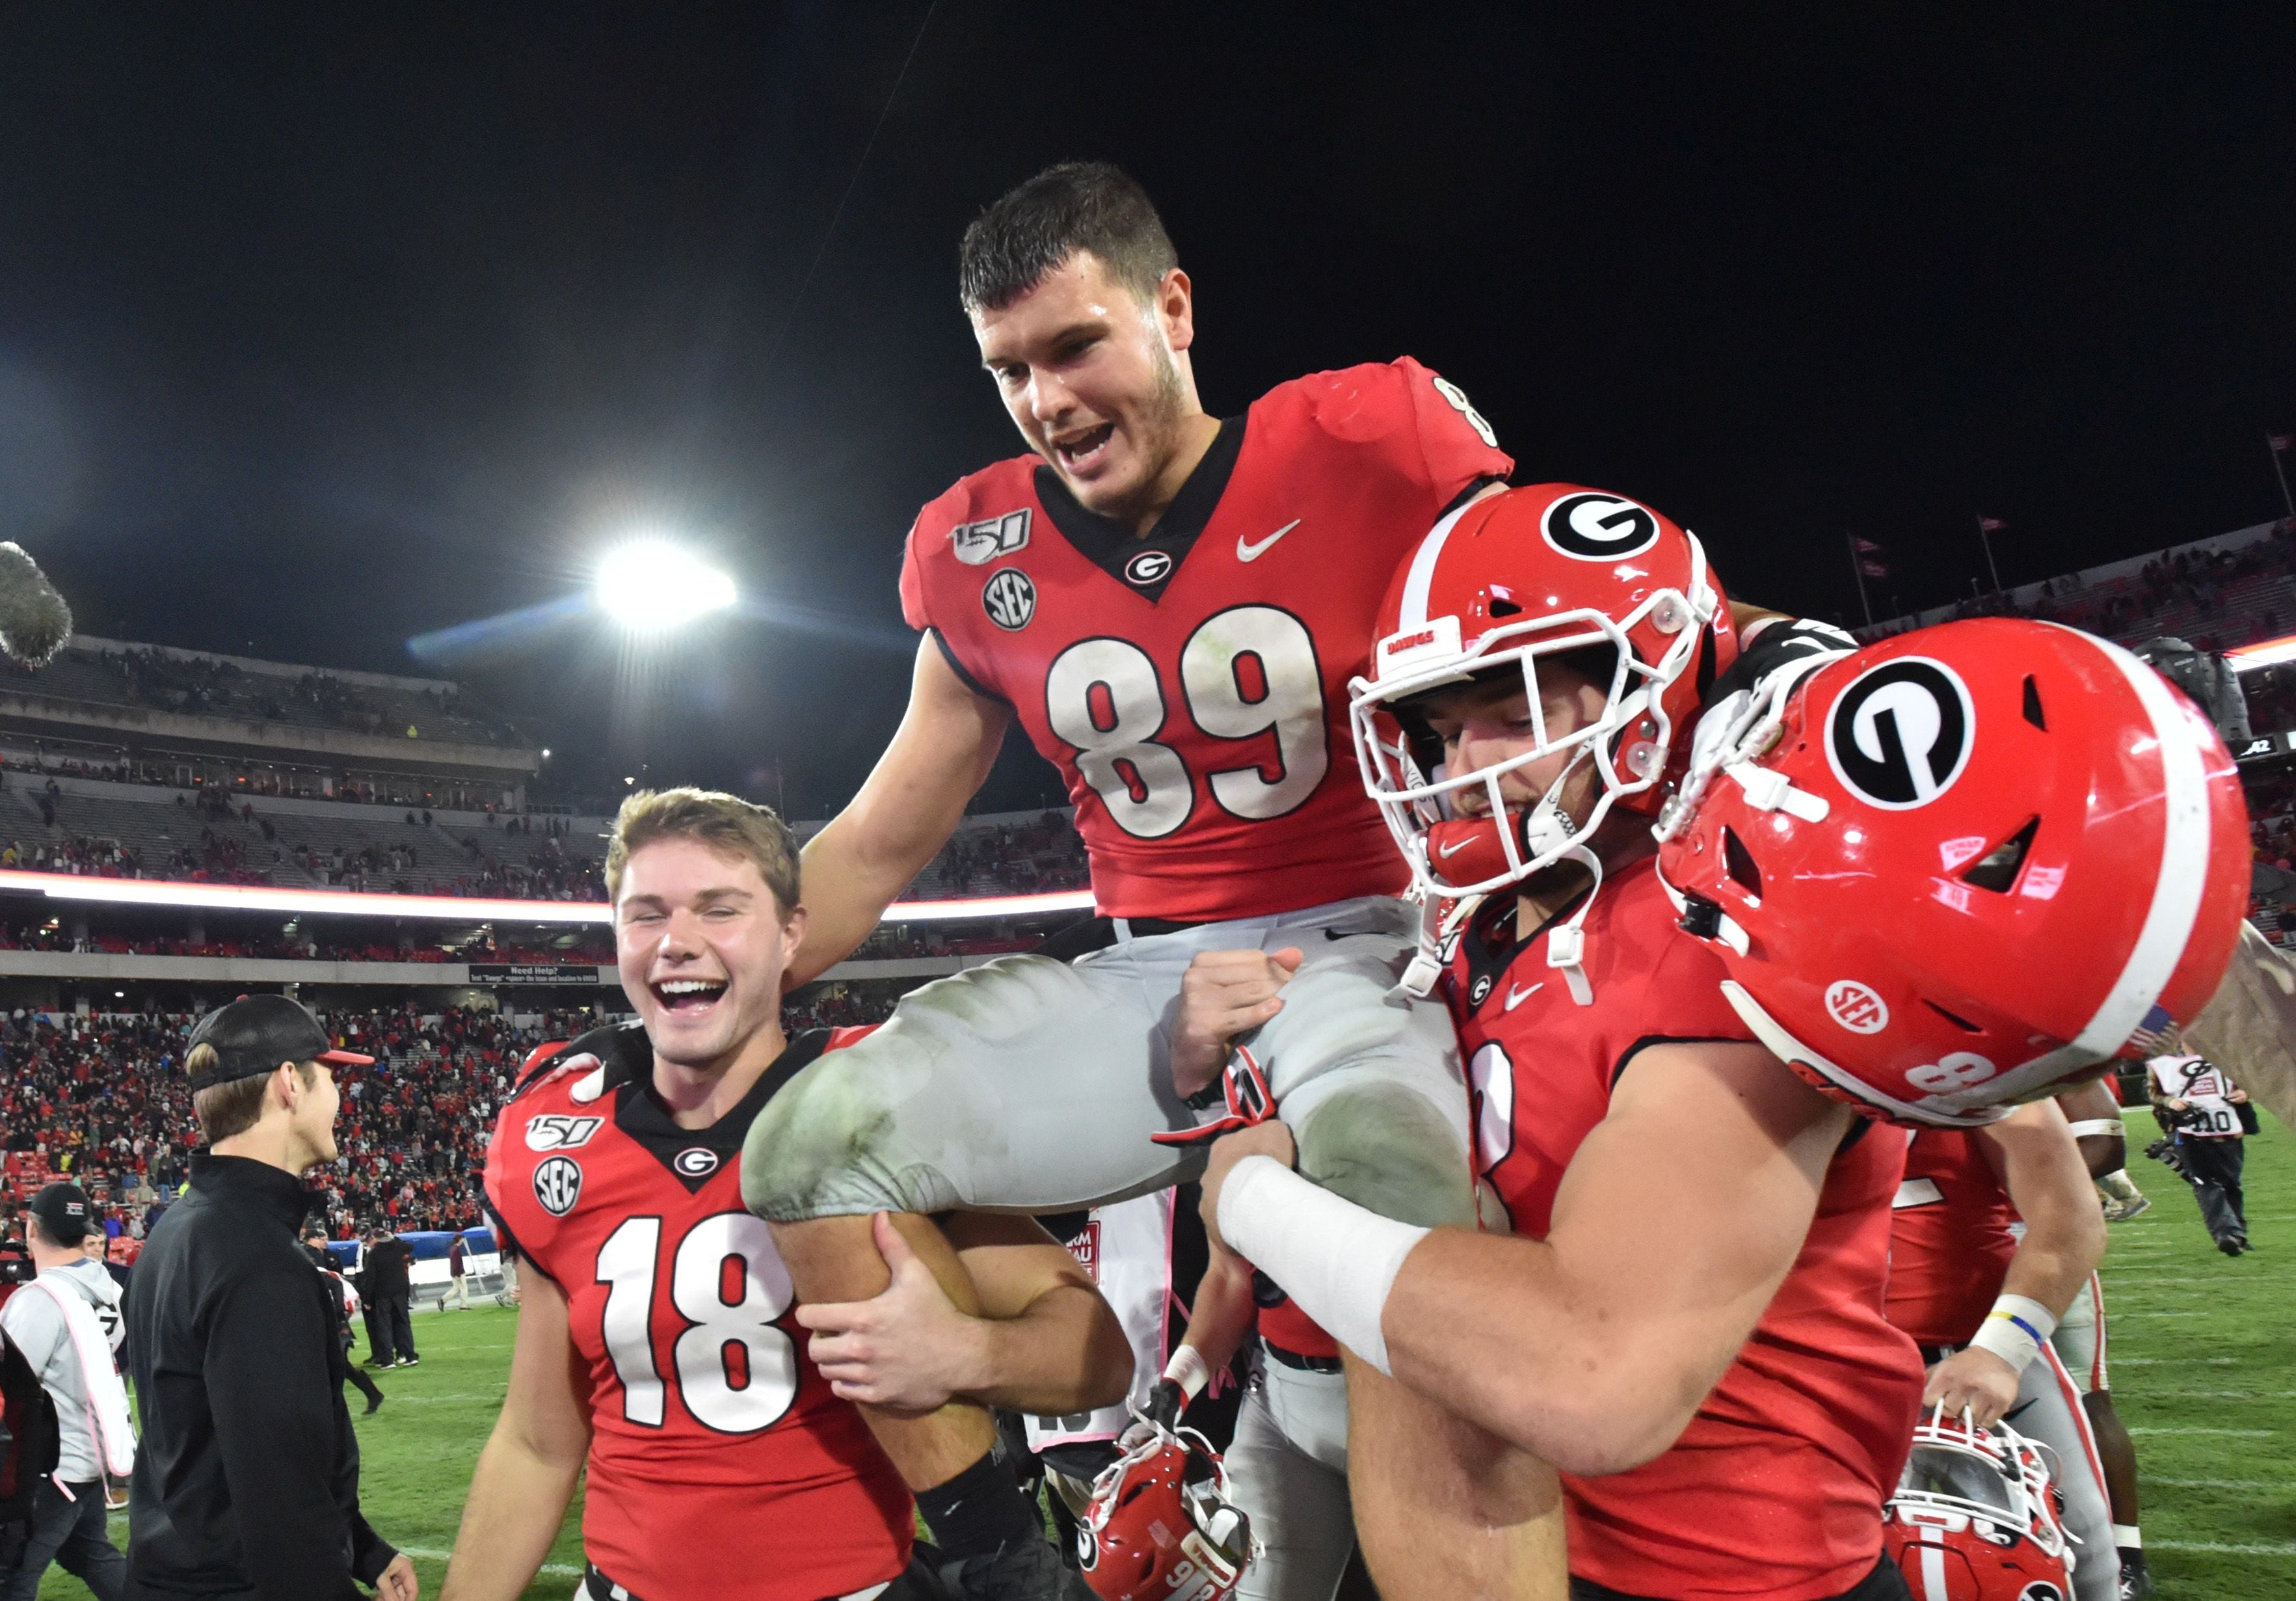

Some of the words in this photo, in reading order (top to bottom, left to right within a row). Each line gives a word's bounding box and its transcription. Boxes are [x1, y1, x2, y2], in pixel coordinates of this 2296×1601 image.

[949, 507, 1033, 565] 150
[1546, 493, 1656, 558] G
[1127, 552, 1170, 584] G
[985, 569, 1034, 629] SEC
[1045, 602, 1331, 841] 89
[1829, 658, 1969, 805] G
[535, 967, 558, 975] Help?
[1828, 982, 1885, 1031] SEC
[526, 1115, 606, 1152] 150
[675, 1148, 717, 1176] G
[533, 1157, 581, 1215] SEC
[1066, 1230, 1091, 1248] RM
[595, 1210, 802, 1435] 18
